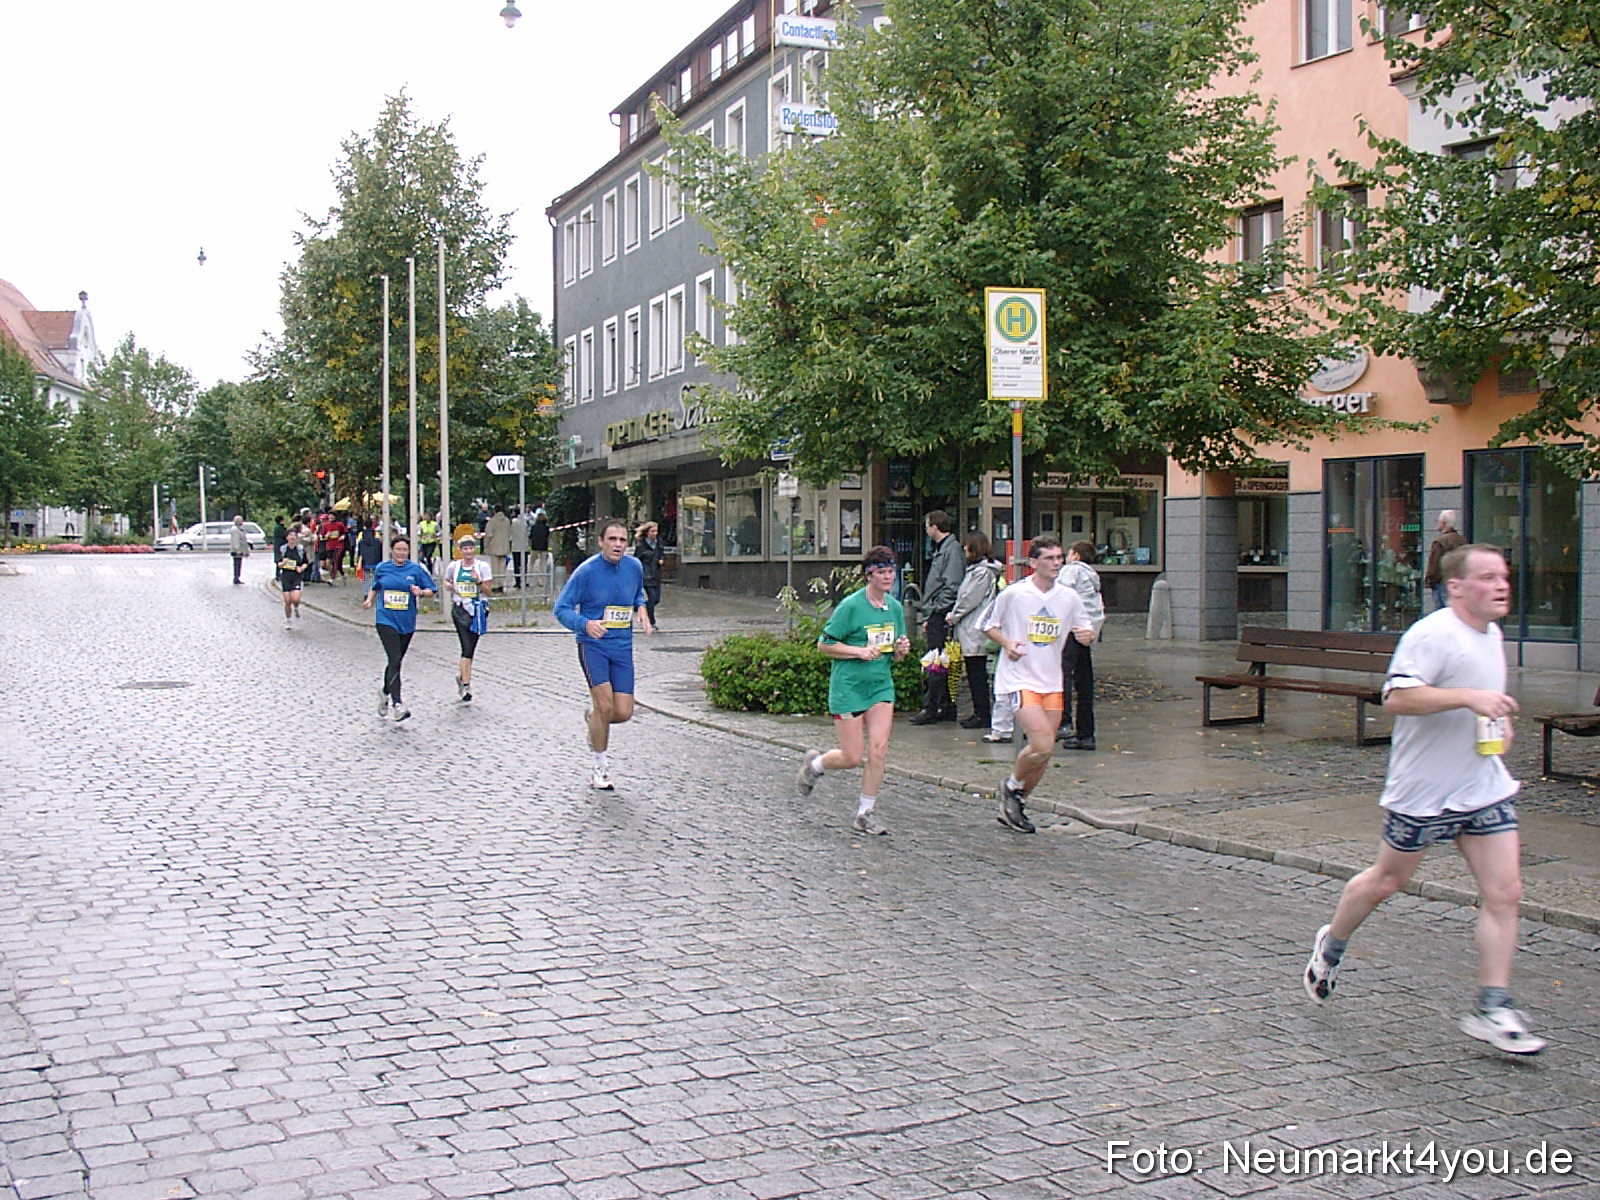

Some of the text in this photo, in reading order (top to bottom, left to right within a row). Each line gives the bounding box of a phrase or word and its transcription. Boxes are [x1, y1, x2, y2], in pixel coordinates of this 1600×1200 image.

[1007, 308, 1026, 332] H
[994, 347, 1039, 355] Oberer Markt
[606, 409, 669, 447] OPTIKER
[496, 458, 515, 472] WC
[610, 611, 630, 621] 1522
[1035, 622, 1059, 635] 1301
